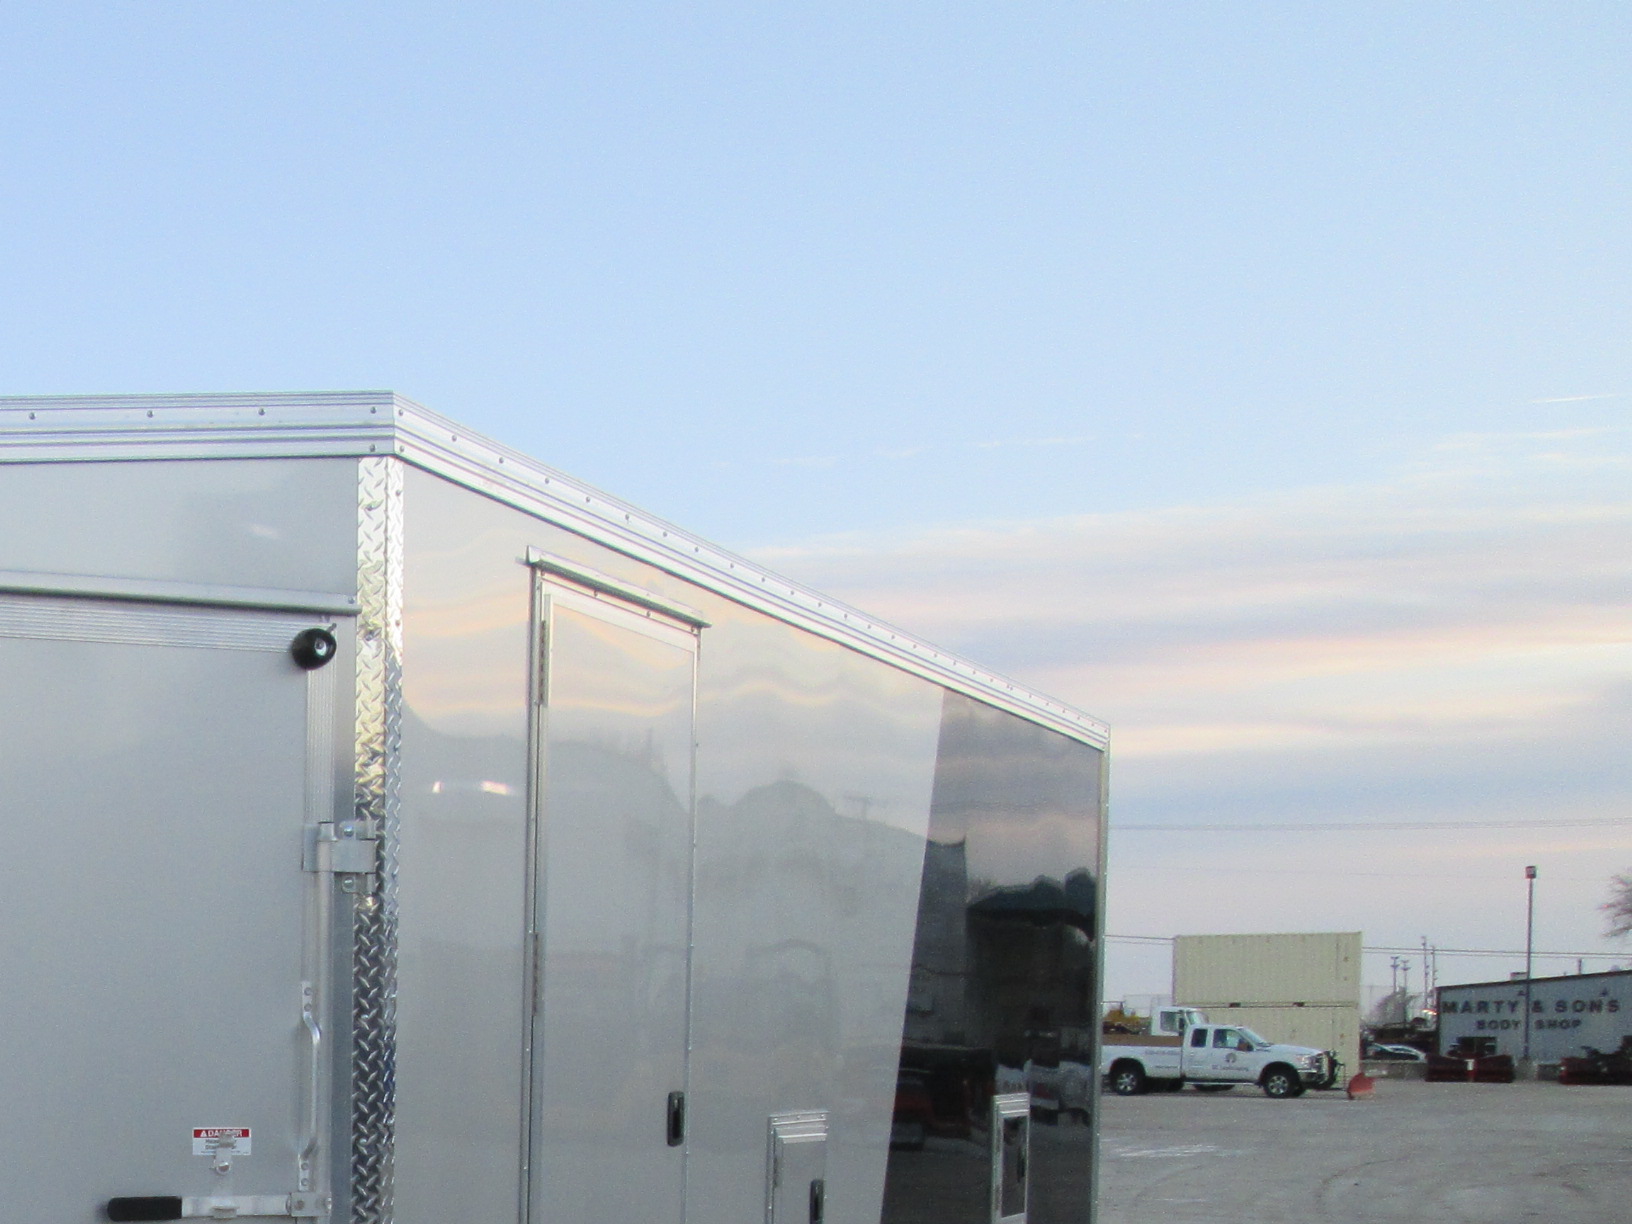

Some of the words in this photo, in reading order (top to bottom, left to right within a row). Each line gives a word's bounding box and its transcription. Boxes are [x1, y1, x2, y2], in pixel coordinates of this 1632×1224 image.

[1441, 1000, 1518, 1014] MARTY
[1531, 1000, 1543, 1013] &
[1554, 1000, 1619, 1013] SONS
[1476, 1019, 1521, 1030] BODY
[1534, 1019, 1582, 1030] SHOP
